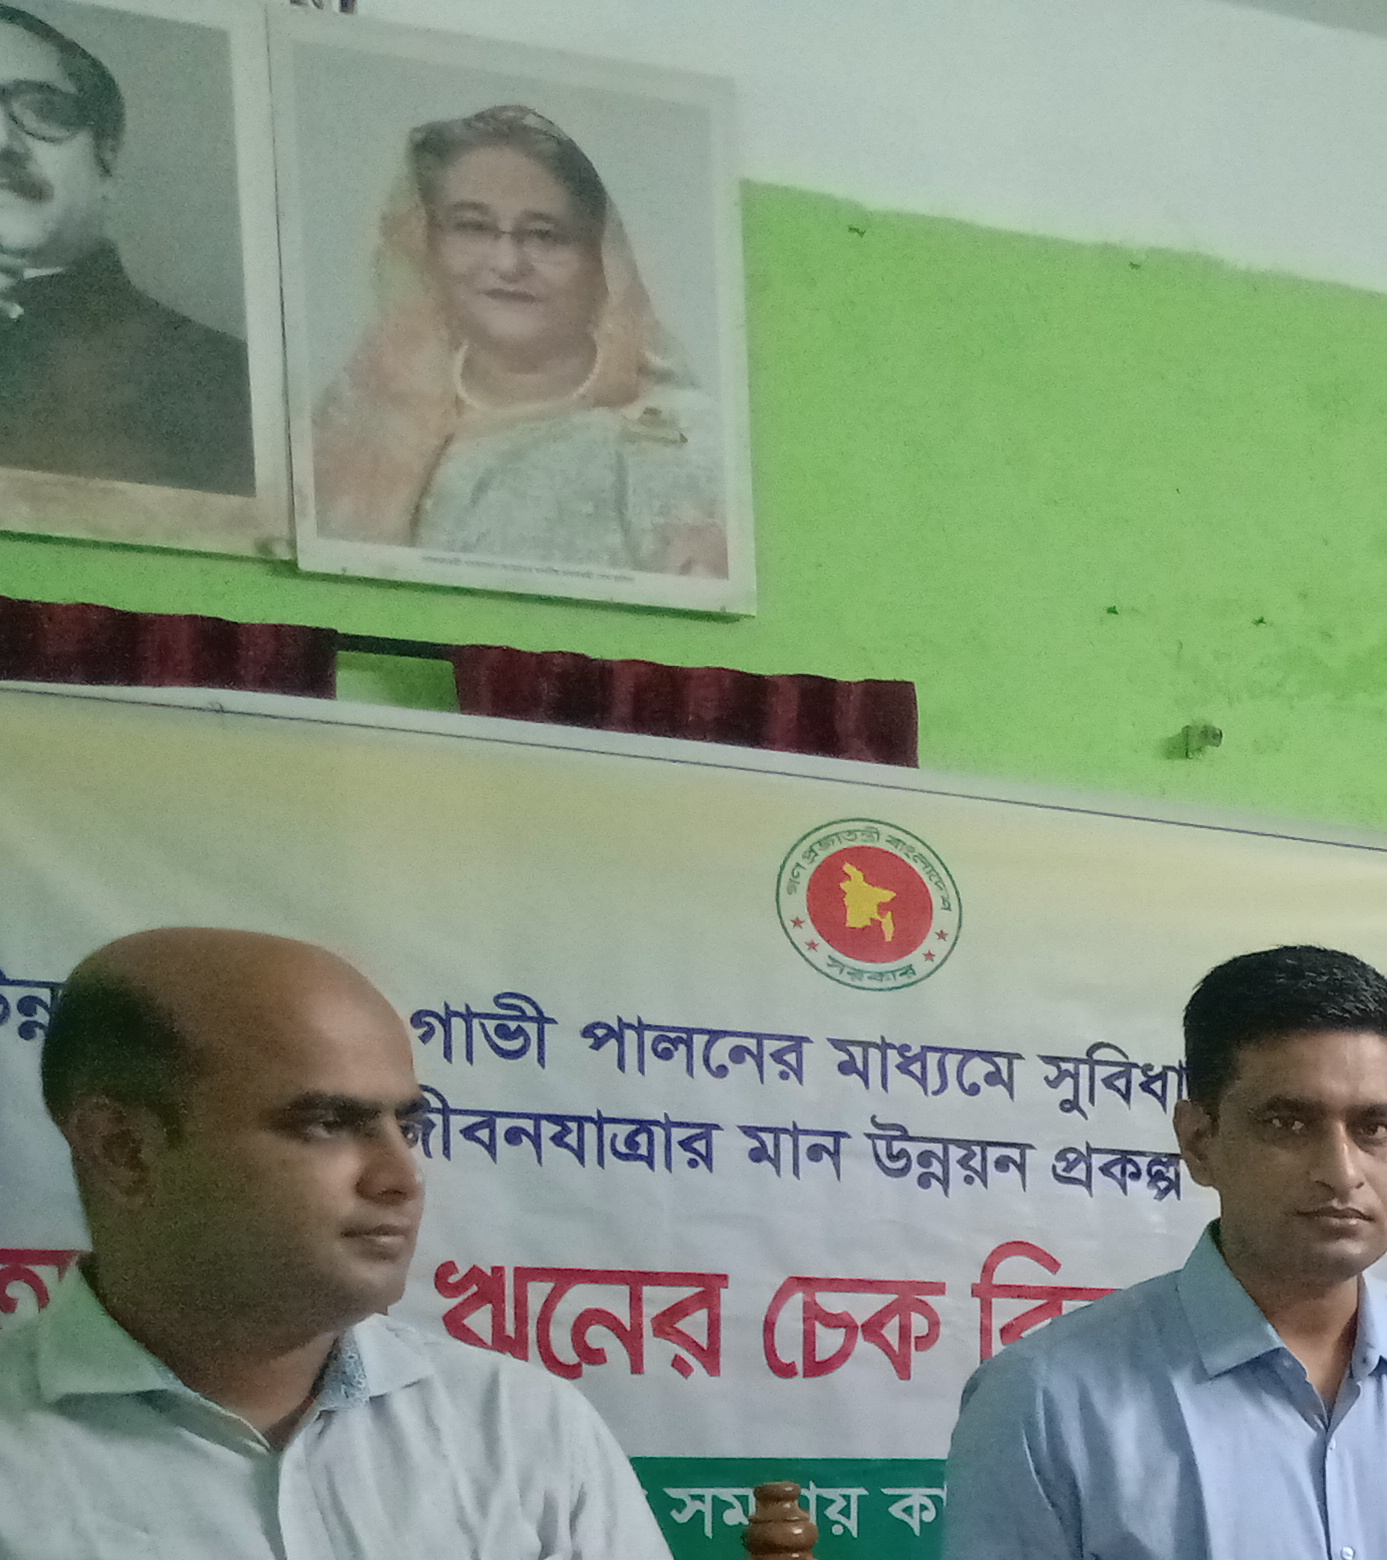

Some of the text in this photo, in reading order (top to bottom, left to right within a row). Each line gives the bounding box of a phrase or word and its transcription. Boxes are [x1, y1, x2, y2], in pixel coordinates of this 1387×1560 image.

[410, 991, 558, 1070] গাভী
[580, 1015, 815, 1086] পালনের
[826, 1034, 1026, 1102] মাধ্যমে
[737, 1119, 852, 1183] মান
[863, 1114, 1036, 1199] উন্নয়ন
[1051, 1141, 1182, 1202] প্রকল্প
[433, 1259, 729, 1381] ঋনের
[763, 1275, 947, 1382] চেক
